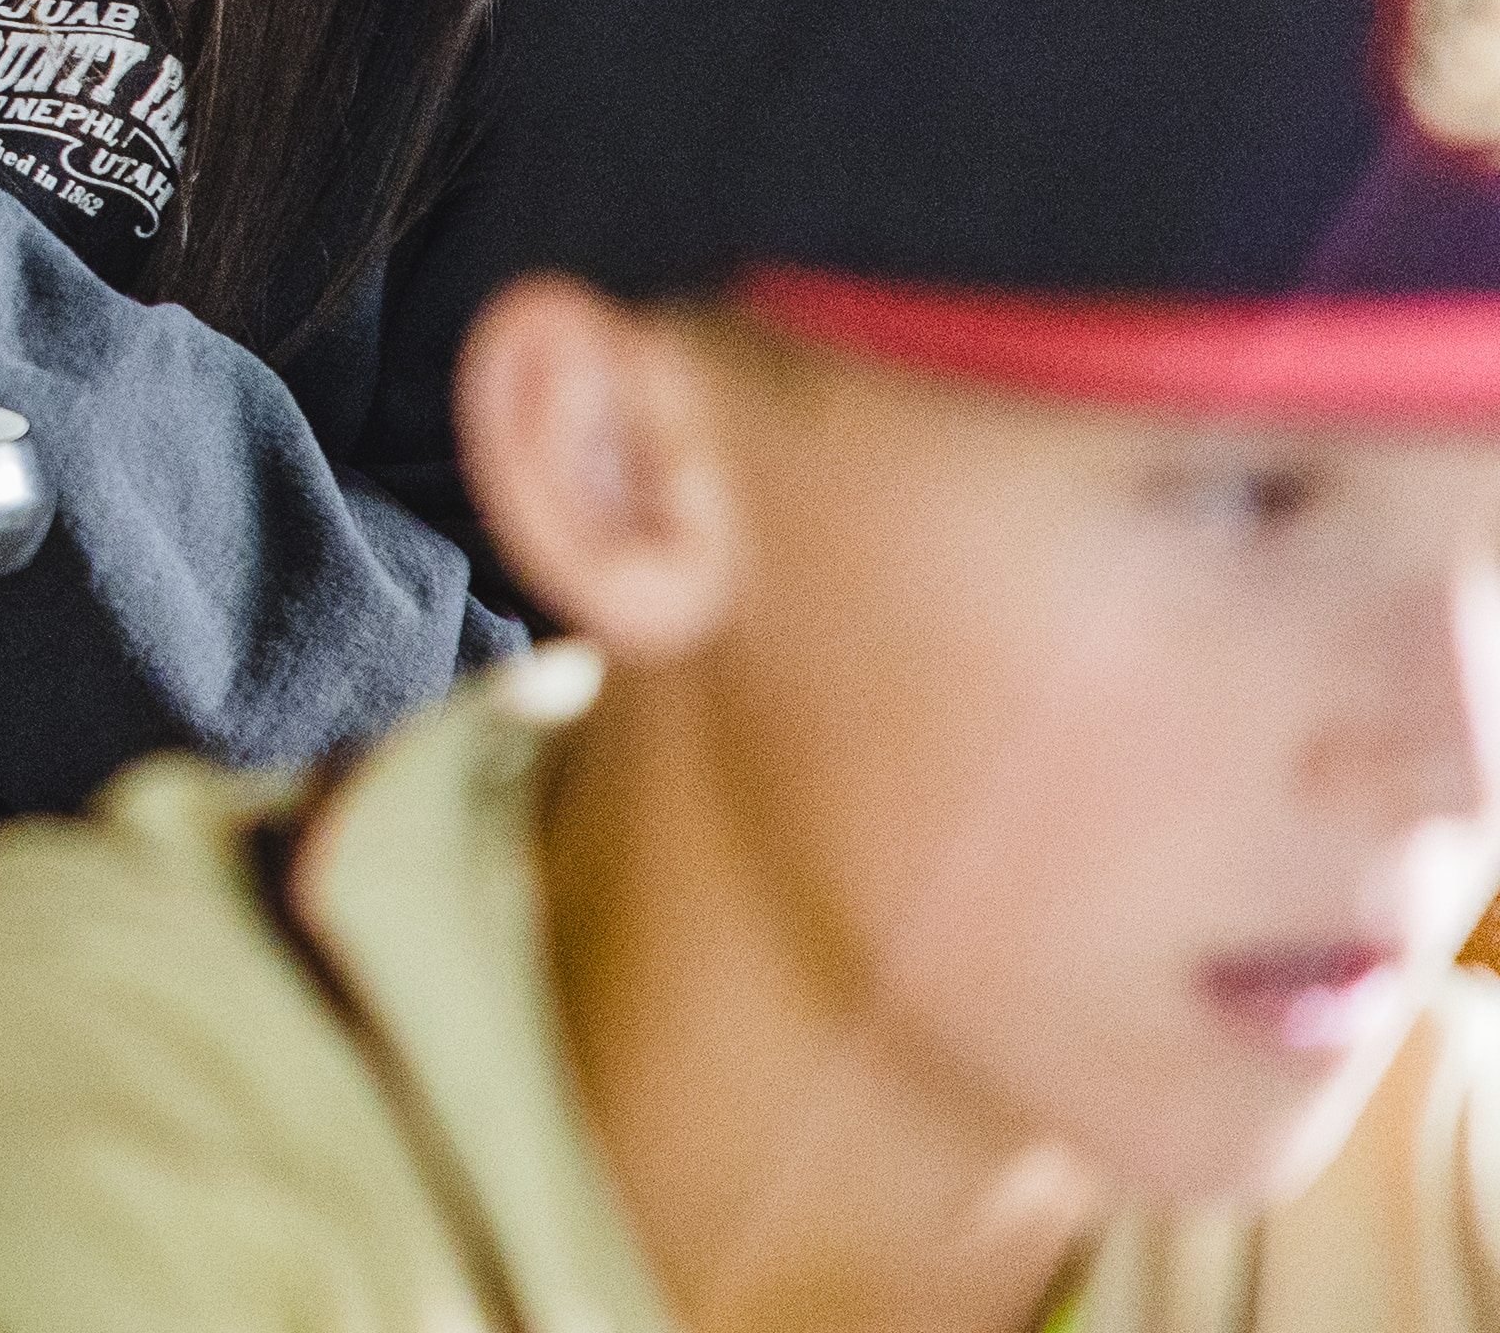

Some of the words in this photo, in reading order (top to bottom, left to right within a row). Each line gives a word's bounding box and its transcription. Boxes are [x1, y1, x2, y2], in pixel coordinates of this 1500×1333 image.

[32, 165, 58, 191] in
[56, 181, 104, 217] 1862
[89, 148, 174, 211] UTAH
